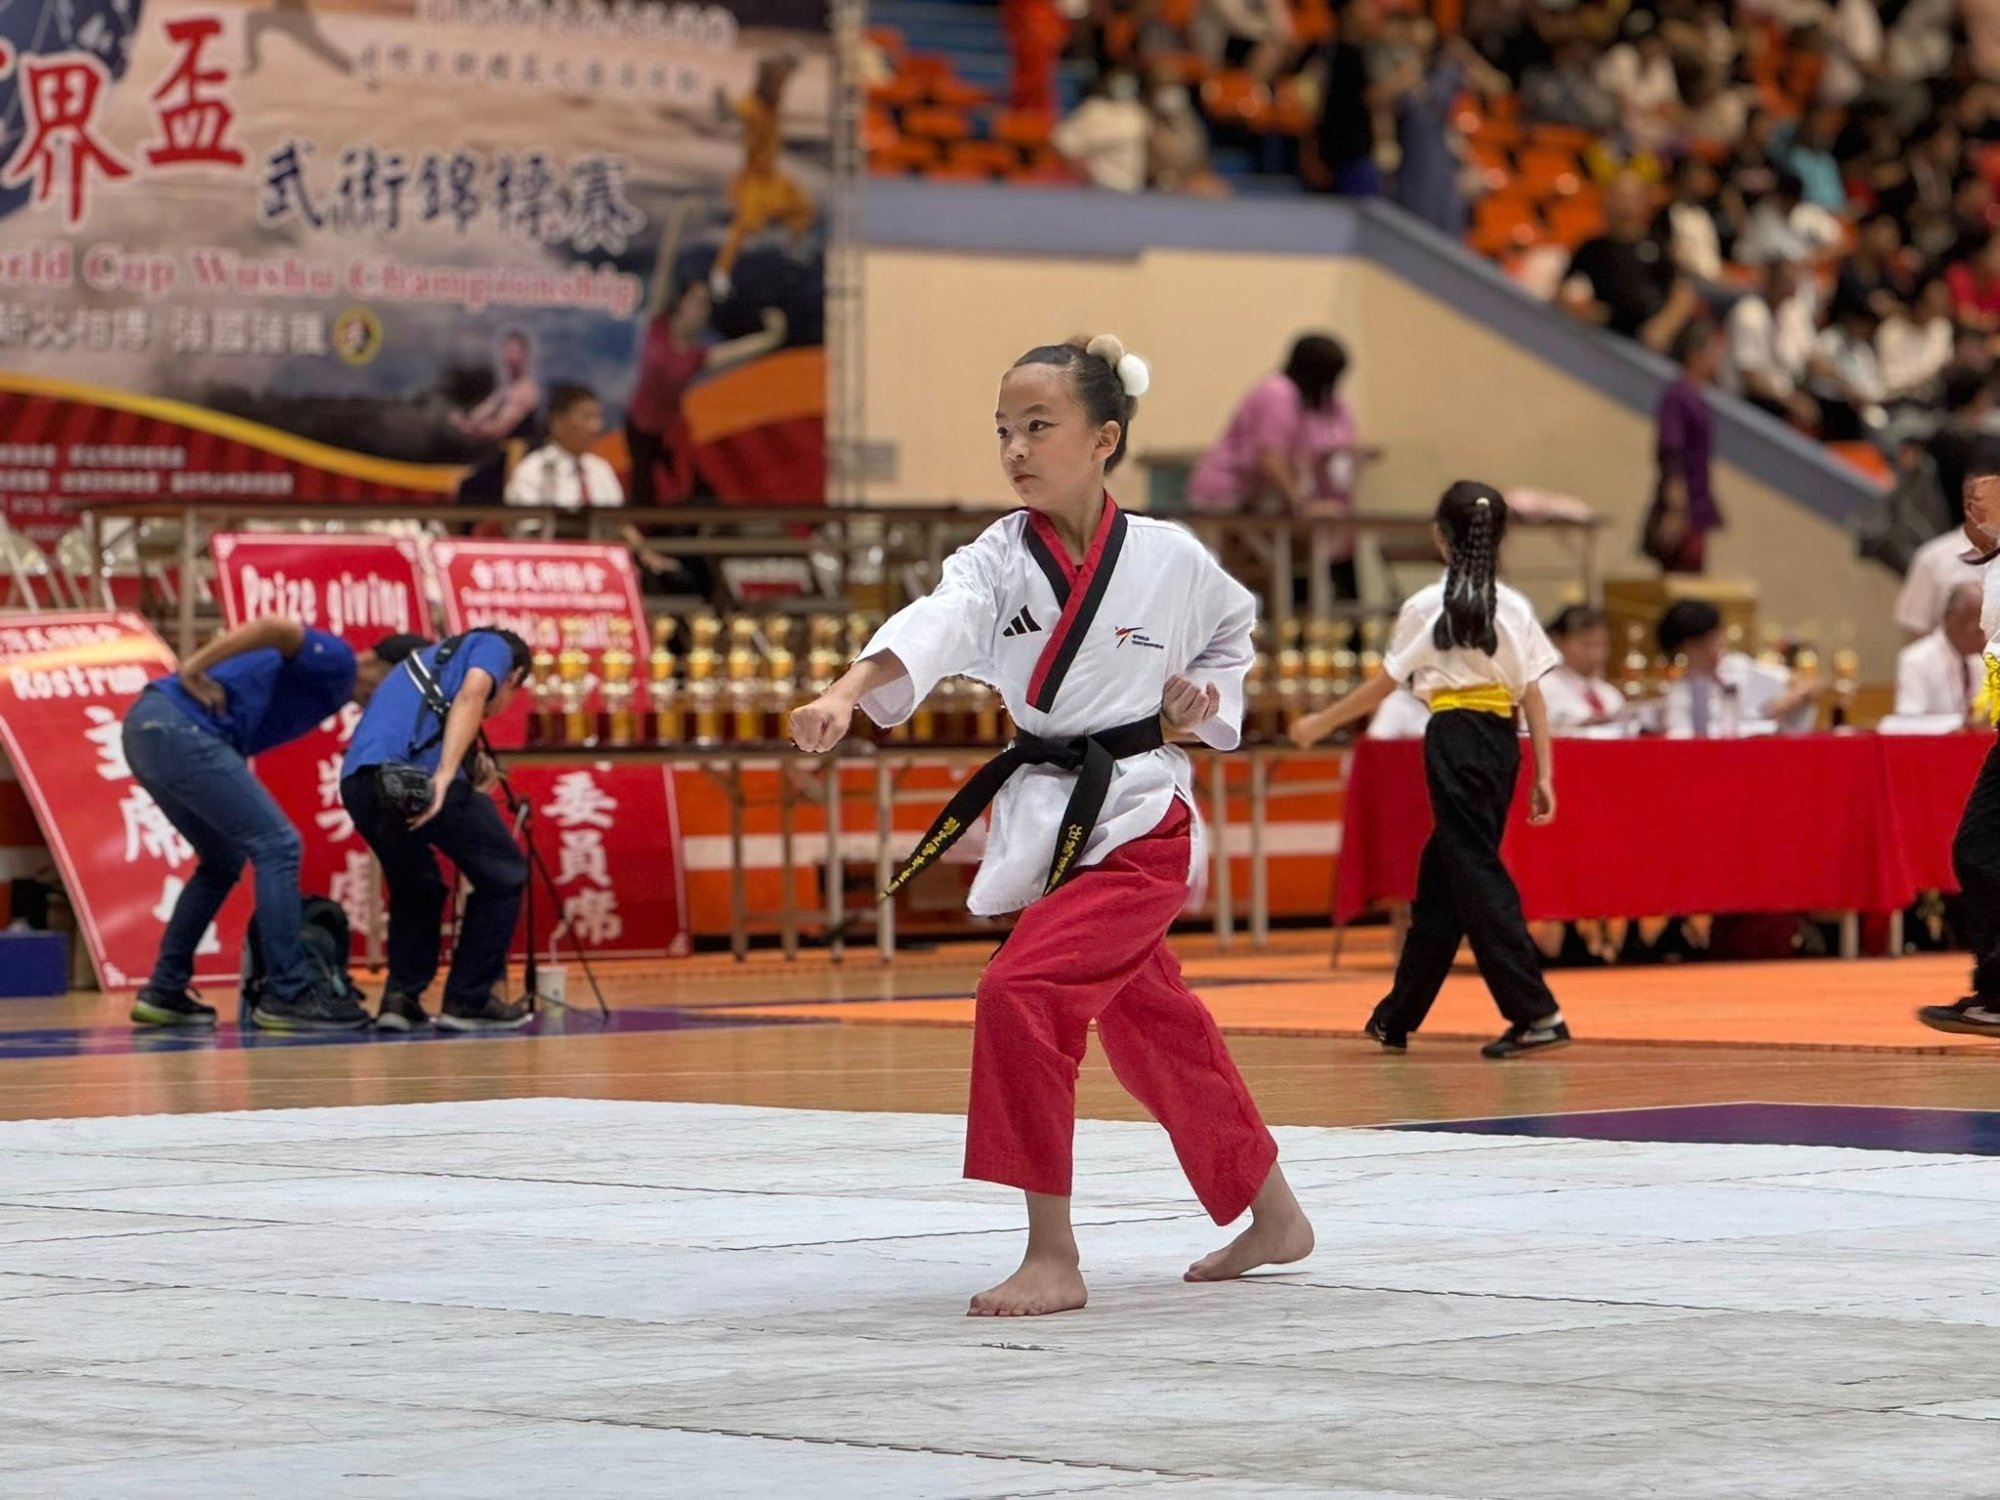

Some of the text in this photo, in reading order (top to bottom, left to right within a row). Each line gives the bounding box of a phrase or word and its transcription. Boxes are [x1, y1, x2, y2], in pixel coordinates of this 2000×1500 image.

[0, 17, 246, 225] 界盃
[0, 246, 642, 317] rld Cup Wushu Championship
[241, 564, 318, 628] Prize
[327, 571, 411, 637] giving
[10, 665, 150, 700] Rostrum
